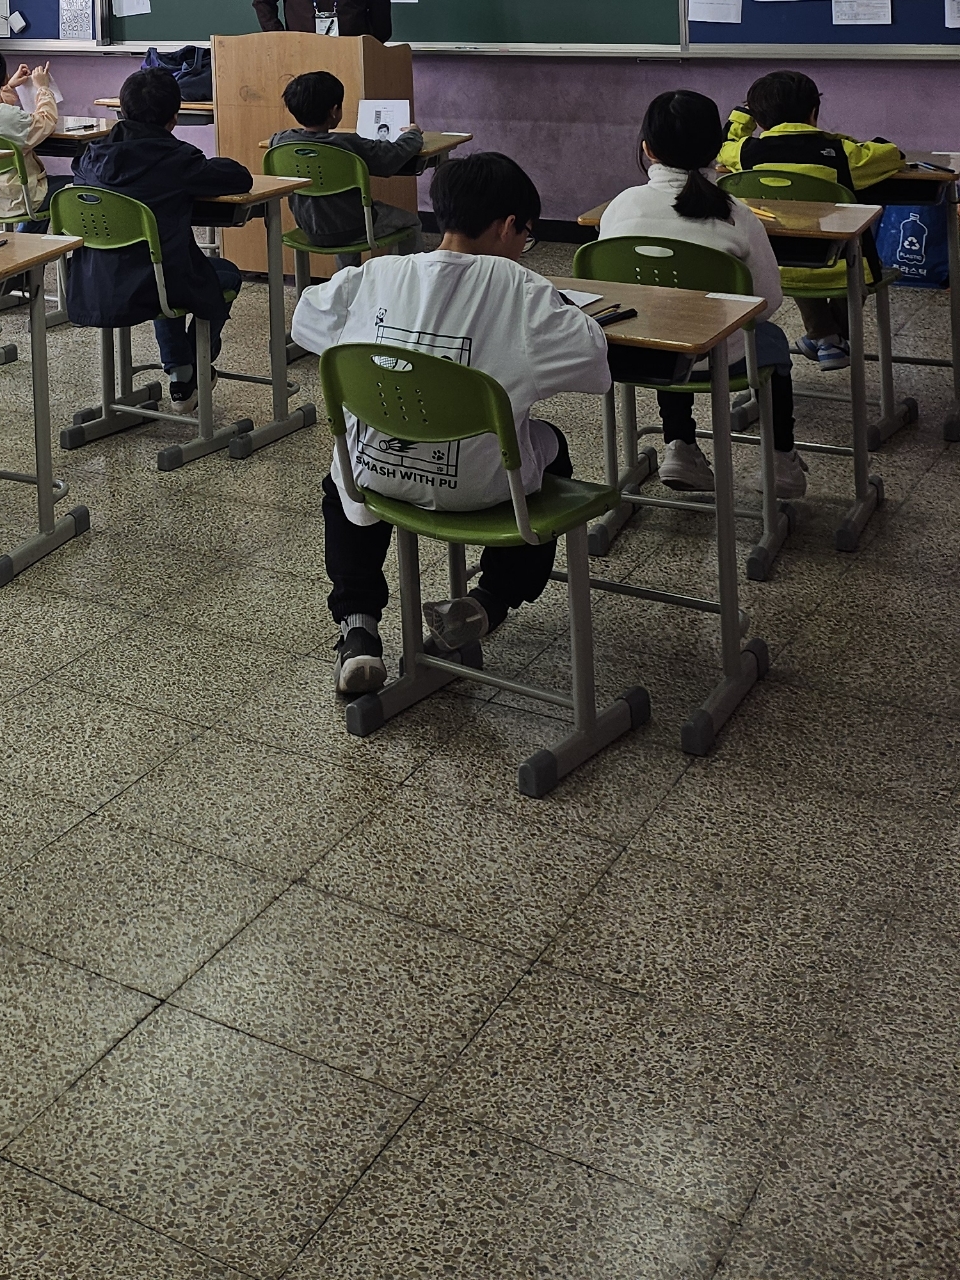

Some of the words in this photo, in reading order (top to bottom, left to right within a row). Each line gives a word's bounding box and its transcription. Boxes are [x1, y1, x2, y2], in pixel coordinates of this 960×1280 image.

[900, 252, 923, 261] PLASTIC
[355, 455, 397, 479] SMASH
[400, 469, 435, 487] WITH
[439, 476, 458, 490] PU
